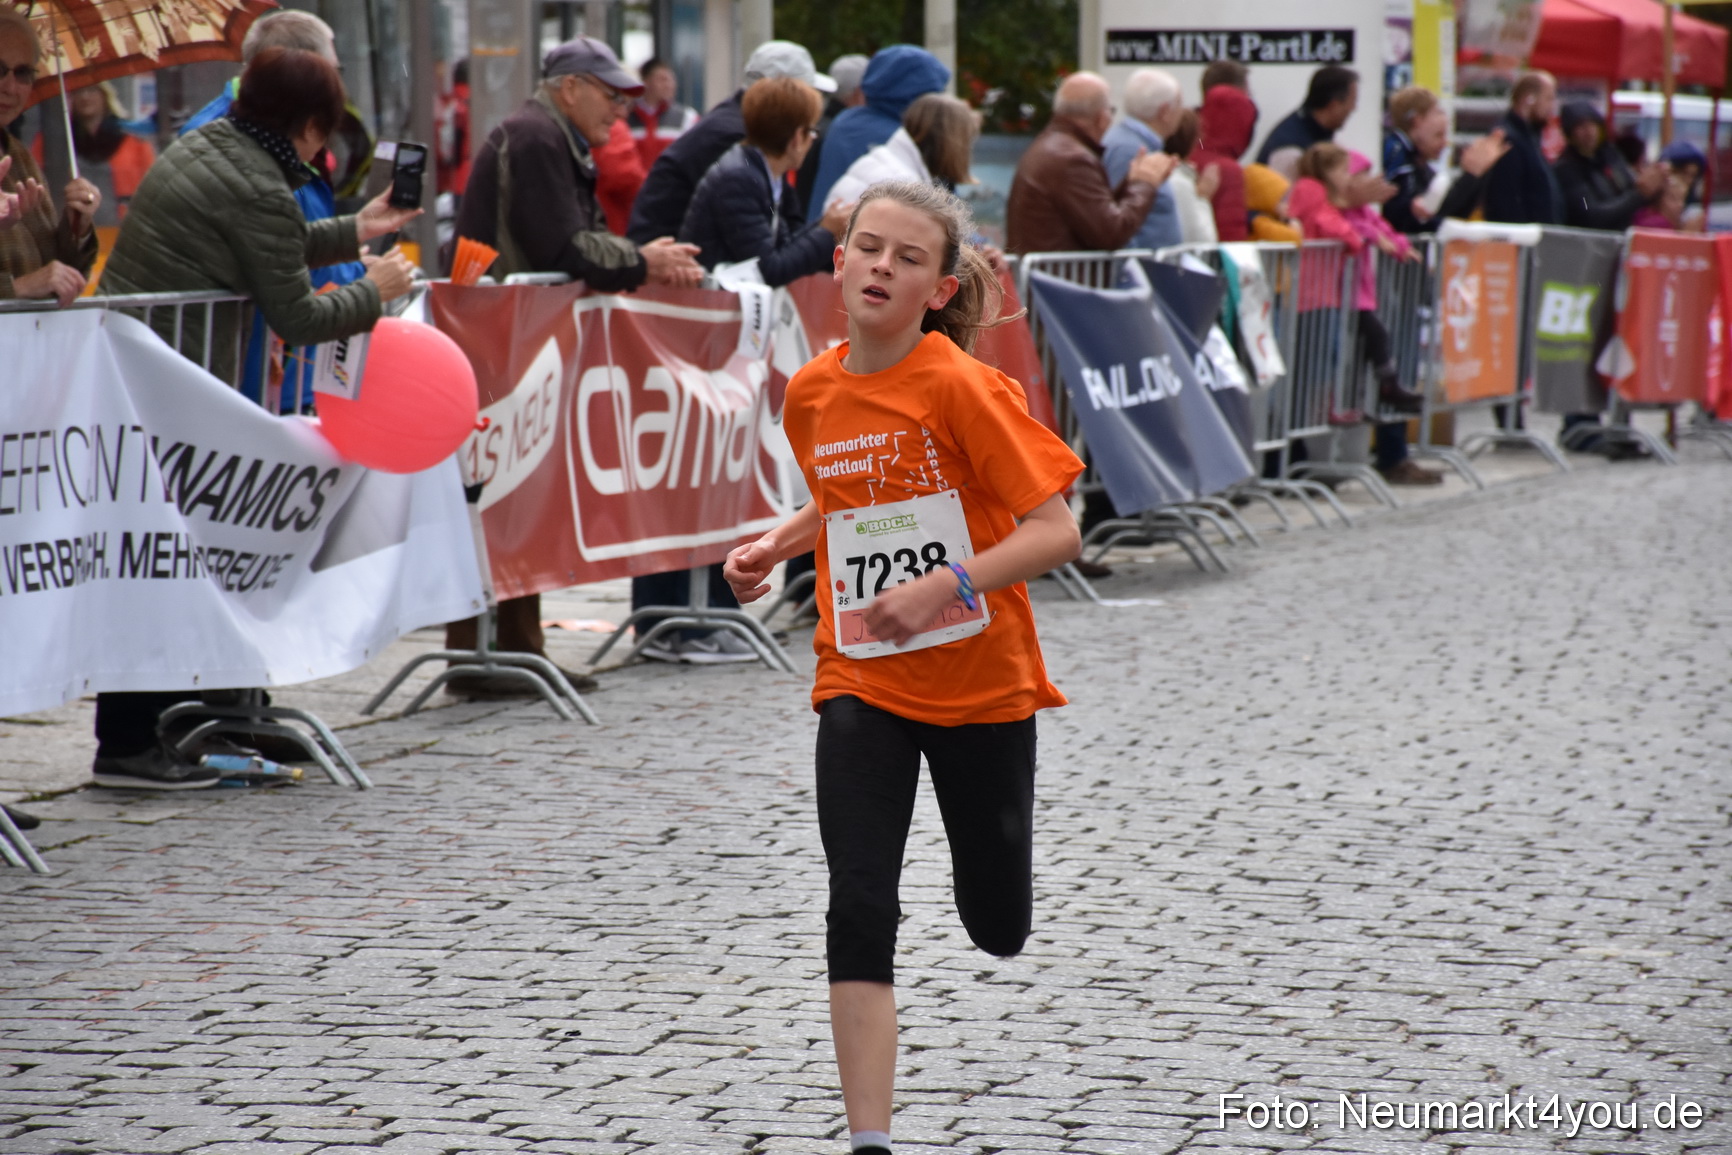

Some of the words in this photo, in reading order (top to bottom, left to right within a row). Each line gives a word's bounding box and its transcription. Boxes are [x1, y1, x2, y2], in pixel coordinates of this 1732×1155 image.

[814, 432, 888, 459] Neumarkter
[814, 453, 874, 480] Stadtlauf
[867, 513, 917, 533] BOCK
